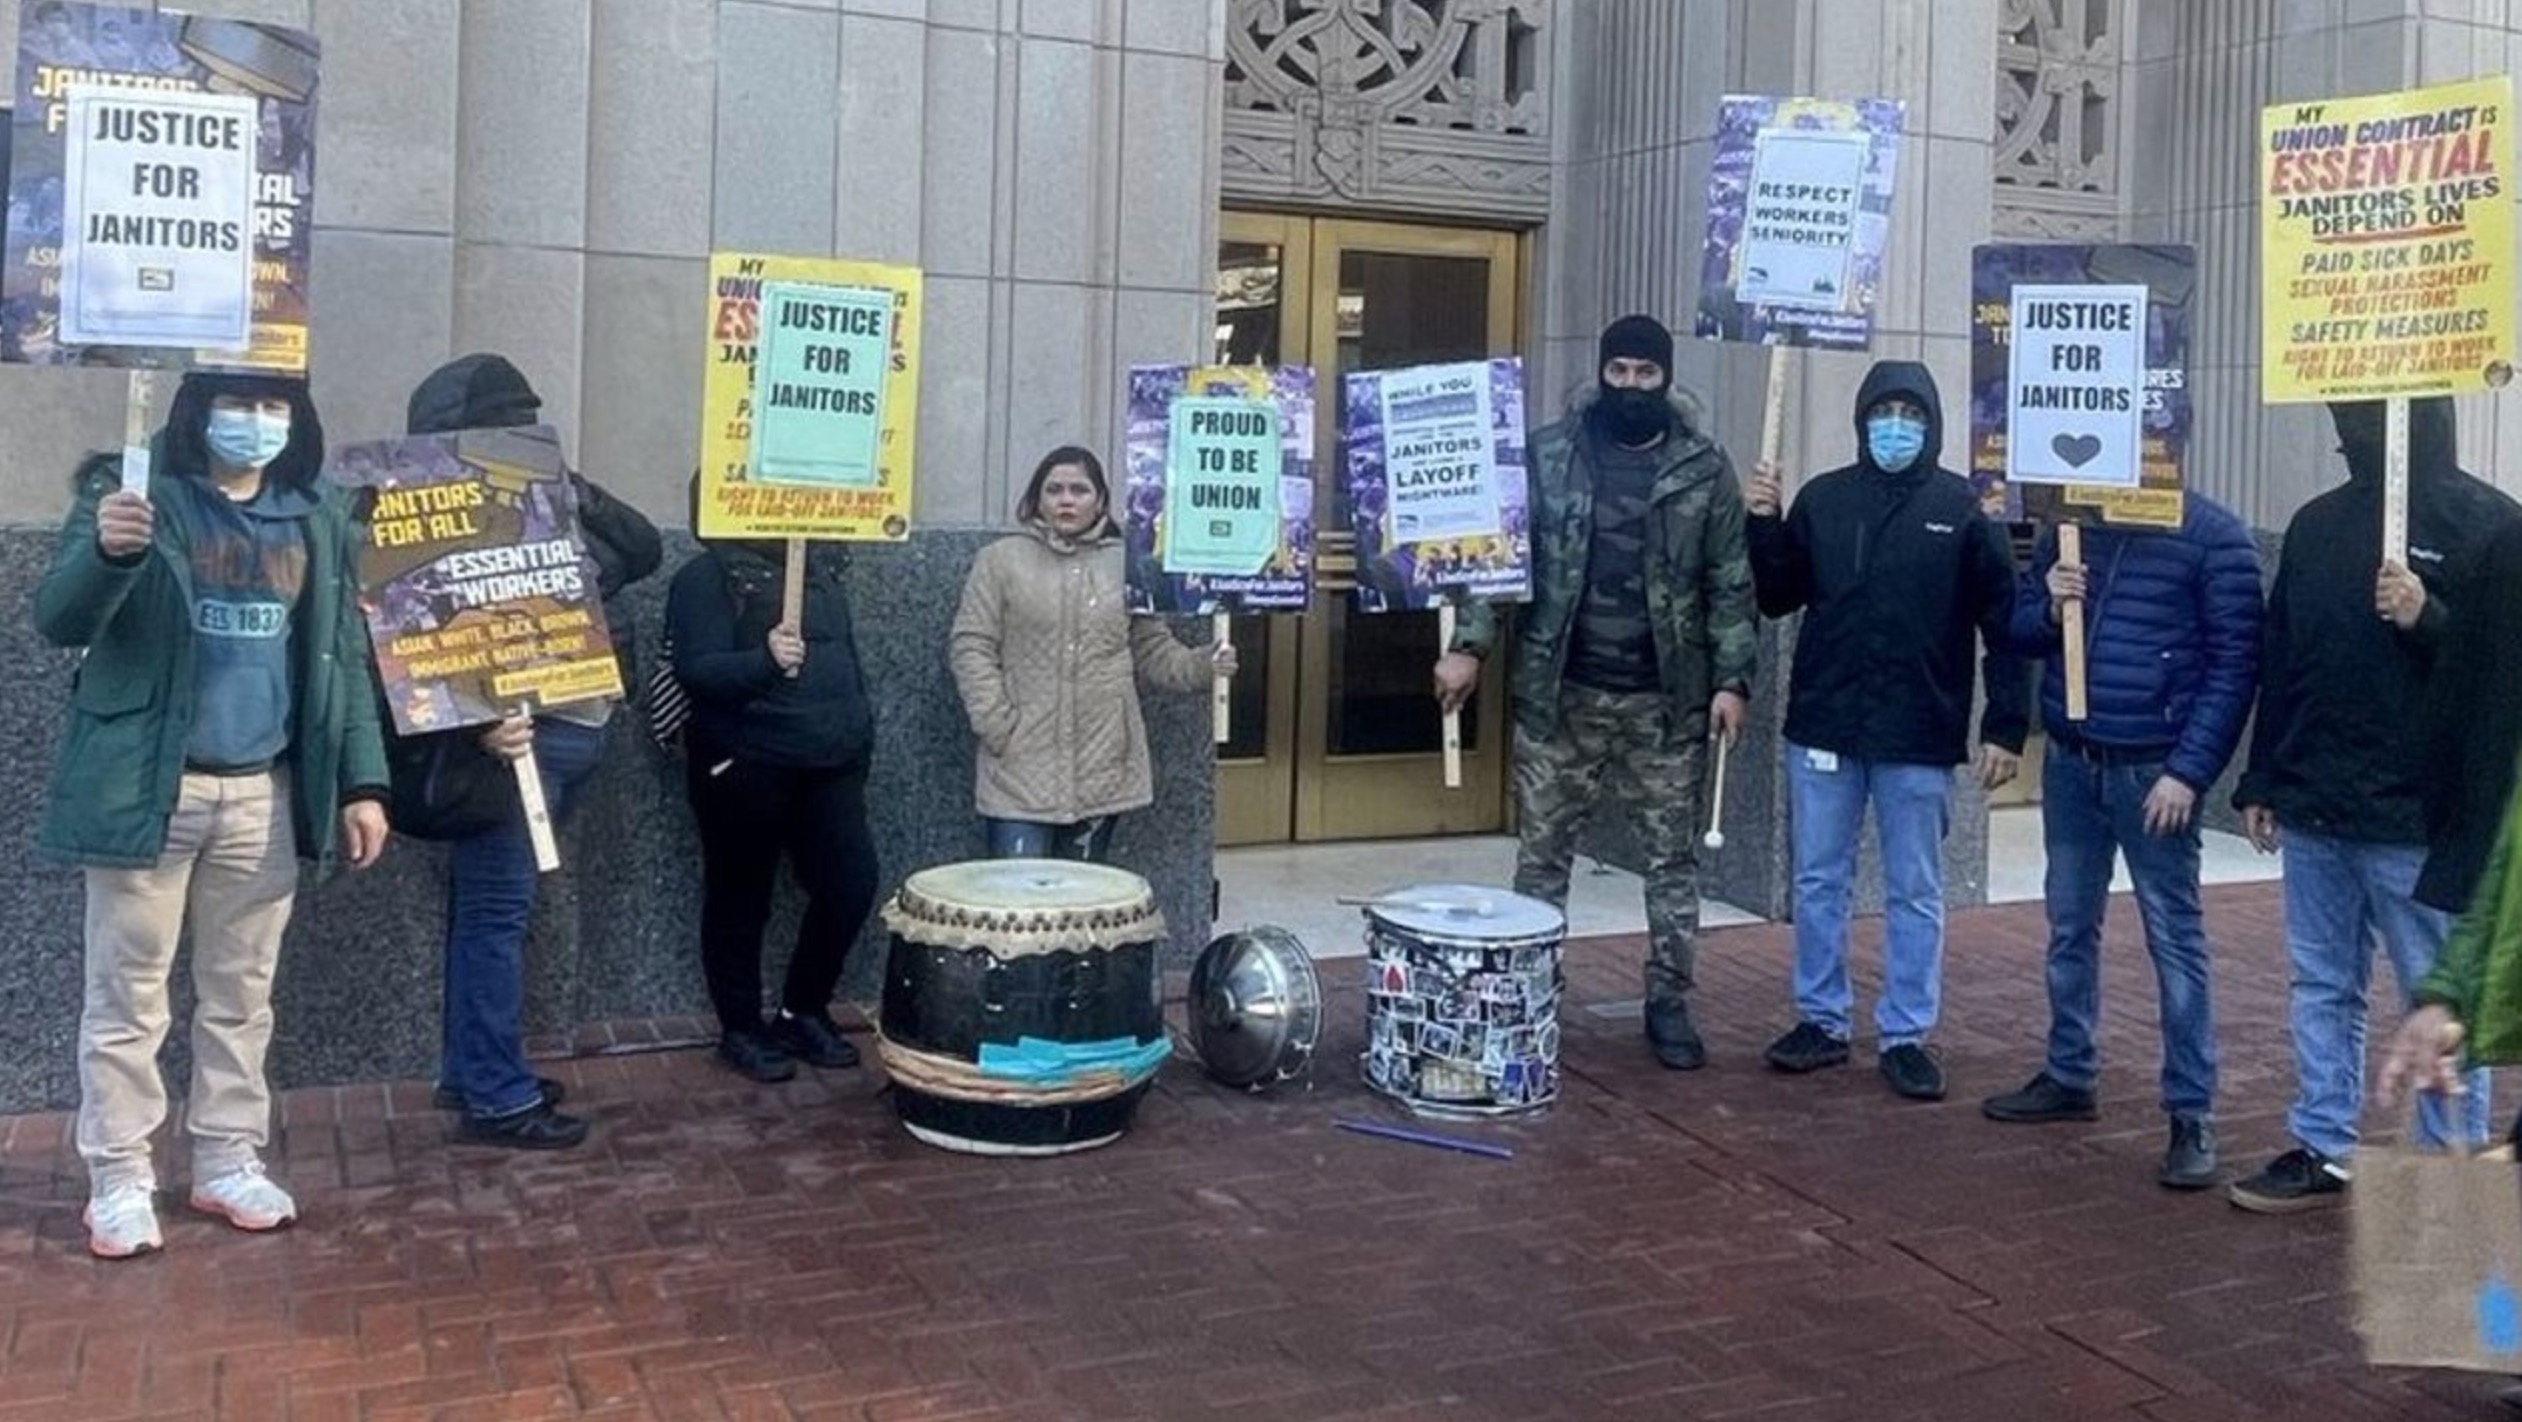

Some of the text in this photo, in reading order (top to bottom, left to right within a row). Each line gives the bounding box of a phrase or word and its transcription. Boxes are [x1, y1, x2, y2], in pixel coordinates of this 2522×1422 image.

[95, 107, 240, 150] JUSTICE
[2270, 106, 2497, 151] UNION CONTRACT IS
[2294, 106, 2325, 124] MY
[2270, 130, 2494, 195] ESSENTIAL
[133, 163, 199, 199] FOR
[1759, 183, 1852, 203] RESPECT
[2278, 177, 2500, 219] JANITORS LIVES
[87, 214, 240, 250] JANITORS
[1755, 207, 1849, 226] WORKERS
[2312, 203, 2465, 236] DEPEND ON
[1751, 226, 1849, 245] SENIORITY
[739, 258, 765, 275] MY
[2301, 239, 2474, 275] PAID SICK DAYS
[2289, 263, 2492, 298] SEXUAL HARASSMENT
[2025, 302, 2131, 331] JUSTICE
[2330, 290, 2458, 315] PROTECTIONS
[780, 301, 881, 336] JUSTICE
[2291, 309, 2489, 344] SAFETY MEASURES
[803, 345, 850, 375] FOR
[2051, 344, 2101, 371] FOR
[769, 383, 876, 416] JANITORS
[1388, 378, 1473, 400] WHILE YOU
[2020, 385, 2130, 411] JANITORS
[1191, 412, 1268, 436] PROUD
[1197, 448, 1259, 473] TO BE
[1391, 437, 1482, 459] JANITORS
[1396, 463, 1481, 488] LAYOFF
[372, 482, 484, 519] ANITORS
[1191, 484, 1262, 509] UNION
[373, 512, 478, 547] FOR ALL
[449, 540, 582, 579] ESSENTIAL
[463, 566, 583, 606] WORKERS
